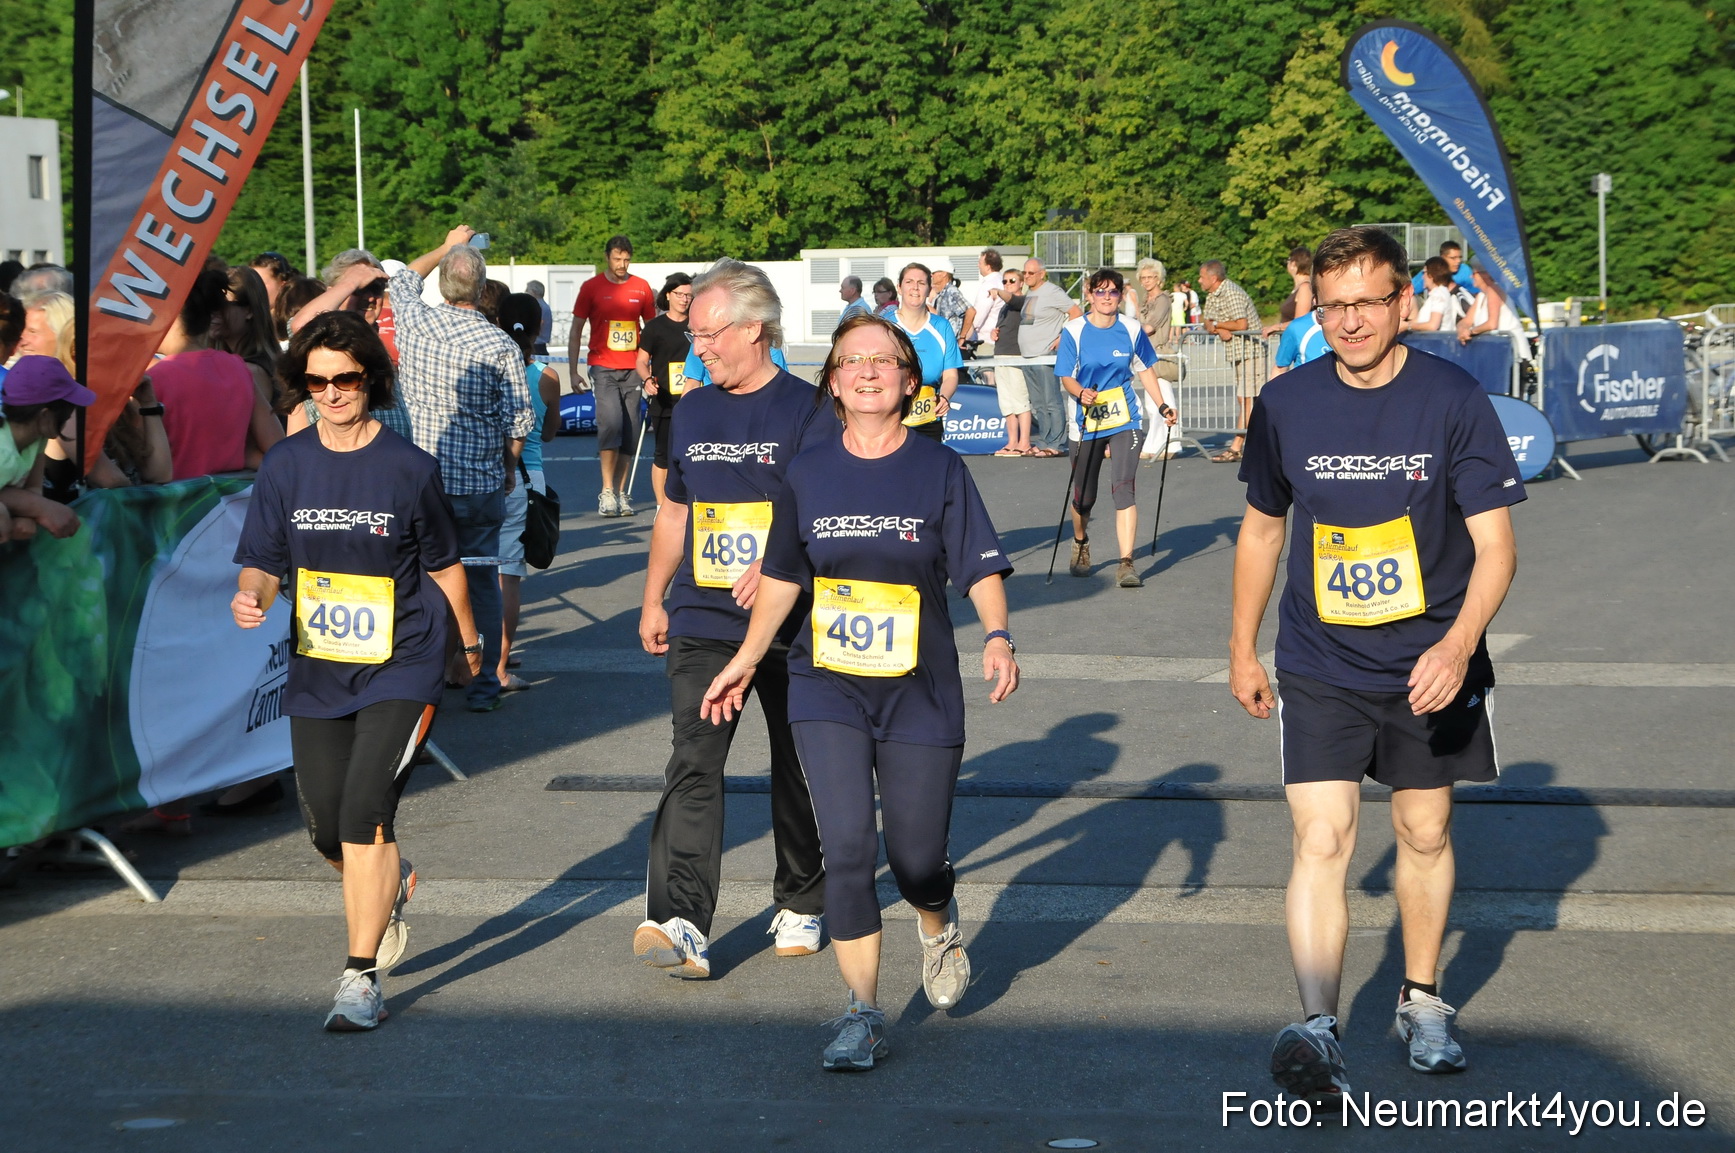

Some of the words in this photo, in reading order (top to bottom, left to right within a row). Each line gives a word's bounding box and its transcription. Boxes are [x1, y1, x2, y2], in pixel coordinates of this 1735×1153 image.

[612, 331, 634, 344] 943
[1594, 370, 1666, 404] Fischer
[1091, 401, 1121, 421] 484
[1600, 404, 1661, 421] AUTOMOBILE
[942, 431, 1004, 443] UTOMOBILE
[685, 442, 779, 459] SPORTSGEIST
[691, 455, 706, 463] WIR
[757, 454, 775, 465] K&L
[1305, 454, 1432, 475] SPORTSGEIST
[1315, 471, 1334, 480] WIR
[1337, 471, 1386, 480] GEWINNT.
[1406, 470, 1428, 481] K&L
[291, 509, 395, 527] SPORTSGEIST
[813, 515, 924, 533] SPORTSGEIST
[370, 525, 389, 537] K&L
[817, 531, 831, 540] WIR
[832, 529, 879, 538] GEWINNT.
[900, 531, 919, 543] K&L
[702, 532, 758, 566] 489
[1327, 557, 1403, 601] 488
[307, 603, 375, 641] 490
[826, 612, 895, 652] 491
